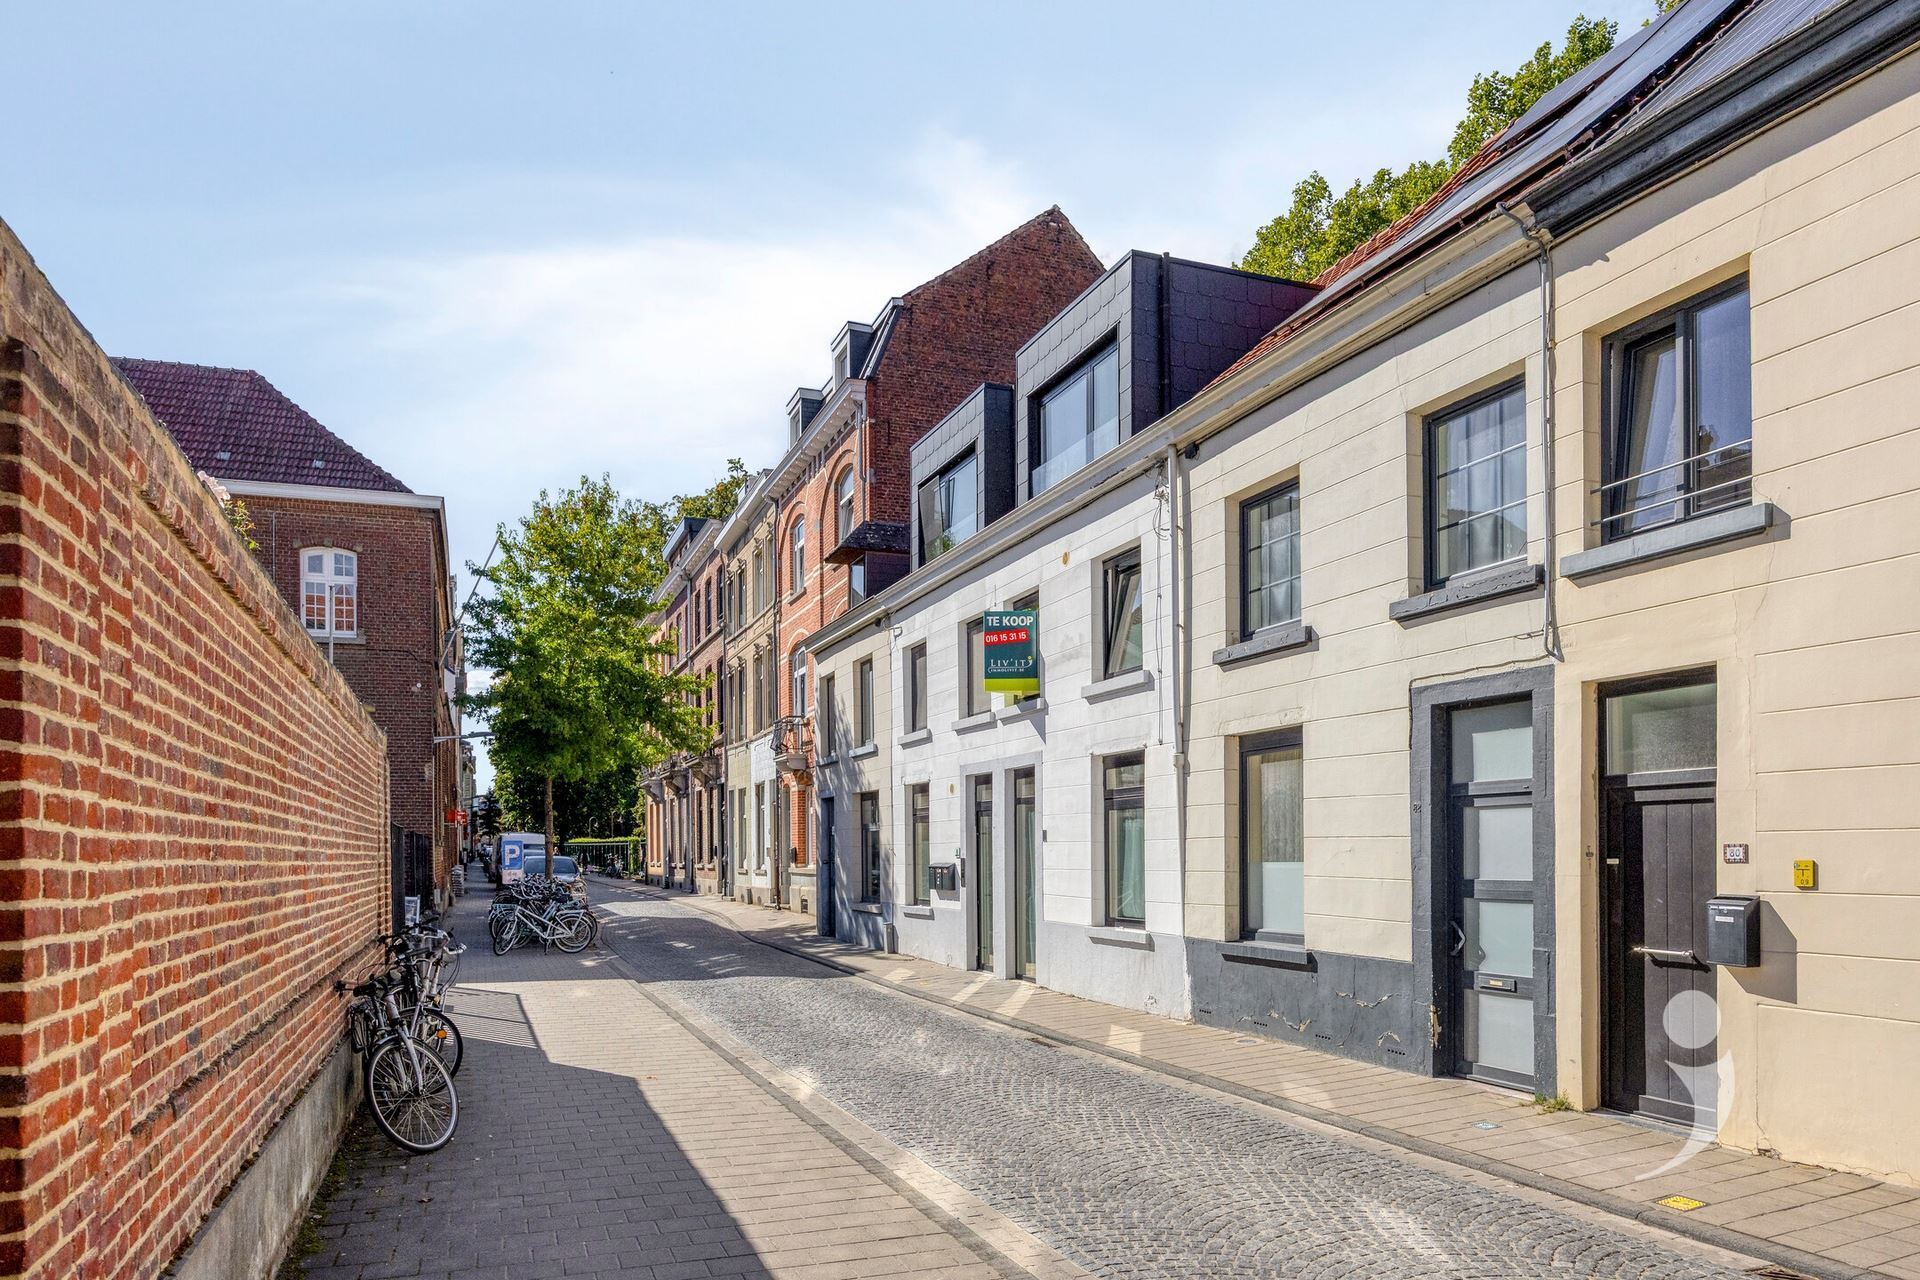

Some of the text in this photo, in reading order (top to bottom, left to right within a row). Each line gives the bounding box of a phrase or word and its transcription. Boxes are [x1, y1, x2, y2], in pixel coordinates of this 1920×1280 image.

[986, 616, 1034, 626] TE KOOP
[986, 635, 998, 643] 016
[504, 845, 520, 865] P
[1729, 849, 1741, 857] 80
